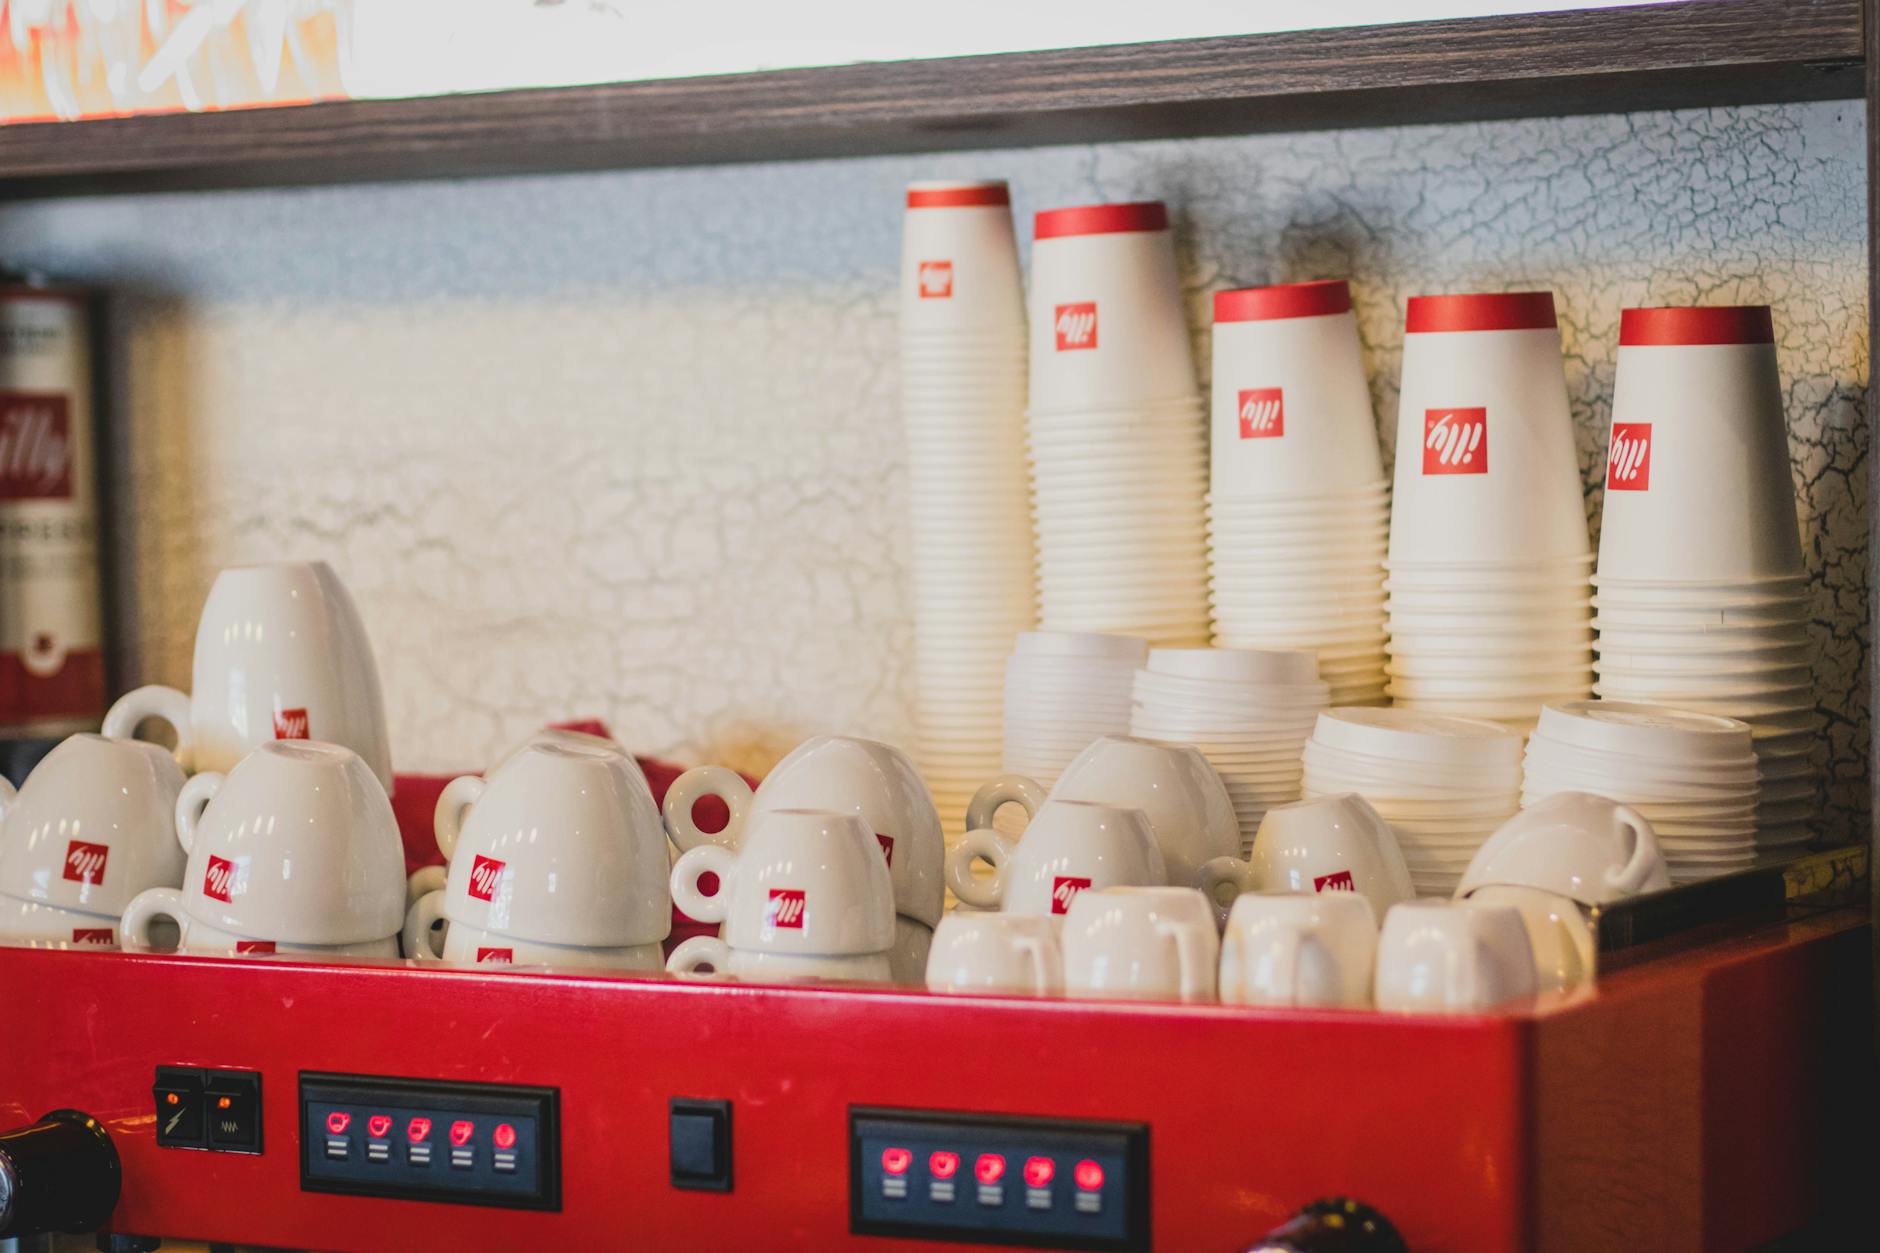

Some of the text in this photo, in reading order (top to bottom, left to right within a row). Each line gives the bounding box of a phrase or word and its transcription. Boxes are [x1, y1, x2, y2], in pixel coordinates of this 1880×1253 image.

[1241, 395, 1280, 431] illy
[1425, 413, 1483, 465] illy
[1611, 429, 1648, 481] illy
[68, 846, 105, 878] illy
